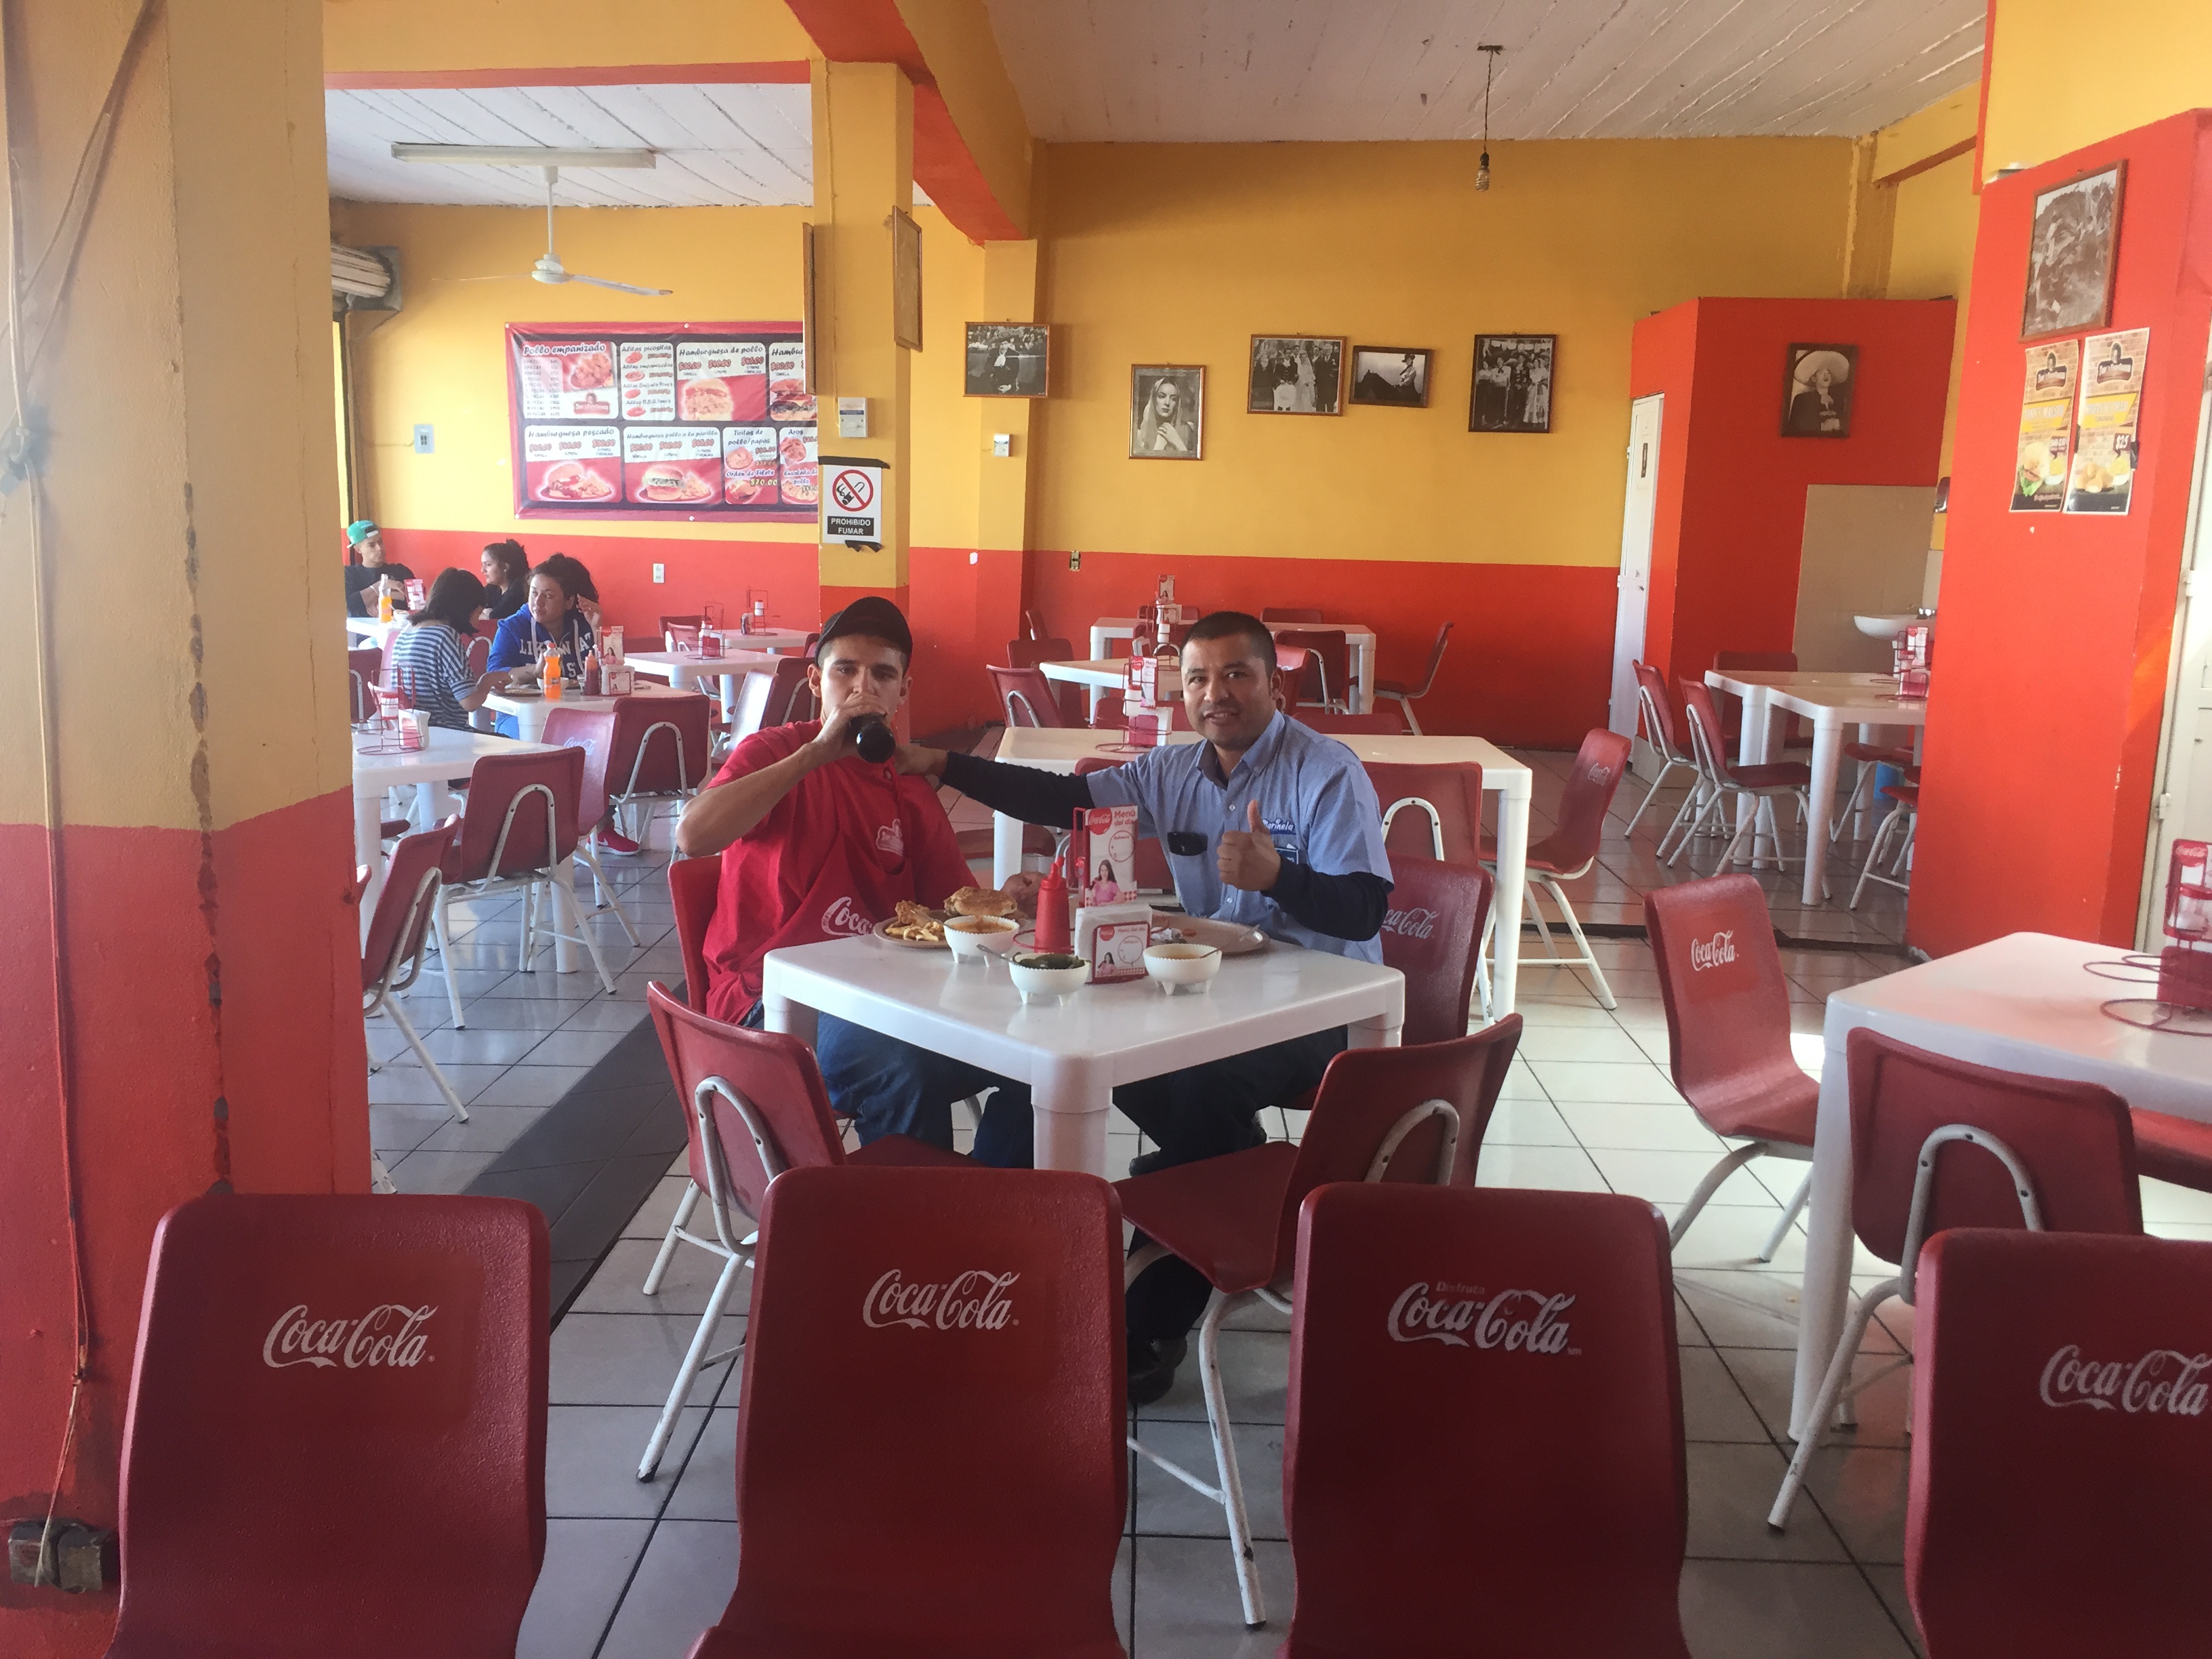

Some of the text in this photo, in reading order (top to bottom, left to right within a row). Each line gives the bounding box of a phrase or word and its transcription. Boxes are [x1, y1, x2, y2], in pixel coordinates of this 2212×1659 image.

[524, 343, 605, 354] Pollo empanizado
[679, 348, 729, 356] Hamburguesa
[741, 346, 763, 354] pollo
[529, 427, 615, 438] Hamburguesa pescado
[2115, 434, 2129, 450] $25
[831, 518, 871, 526] PROHIBIDO
[1114, 809, 1136, 818] Menú
[1691, 930, 1736, 971] Coca-Cola
[1435, 1281, 1486, 1295] Disfruta
[863, 1269, 1020, 1330] Coca-Cola
[1387, 1282, 1576, 1354] Coca-Cola
[263, 1305, 438, 1368] Coca-Cola
[2039, 1345, 2212, 1416] Coca-Cola
